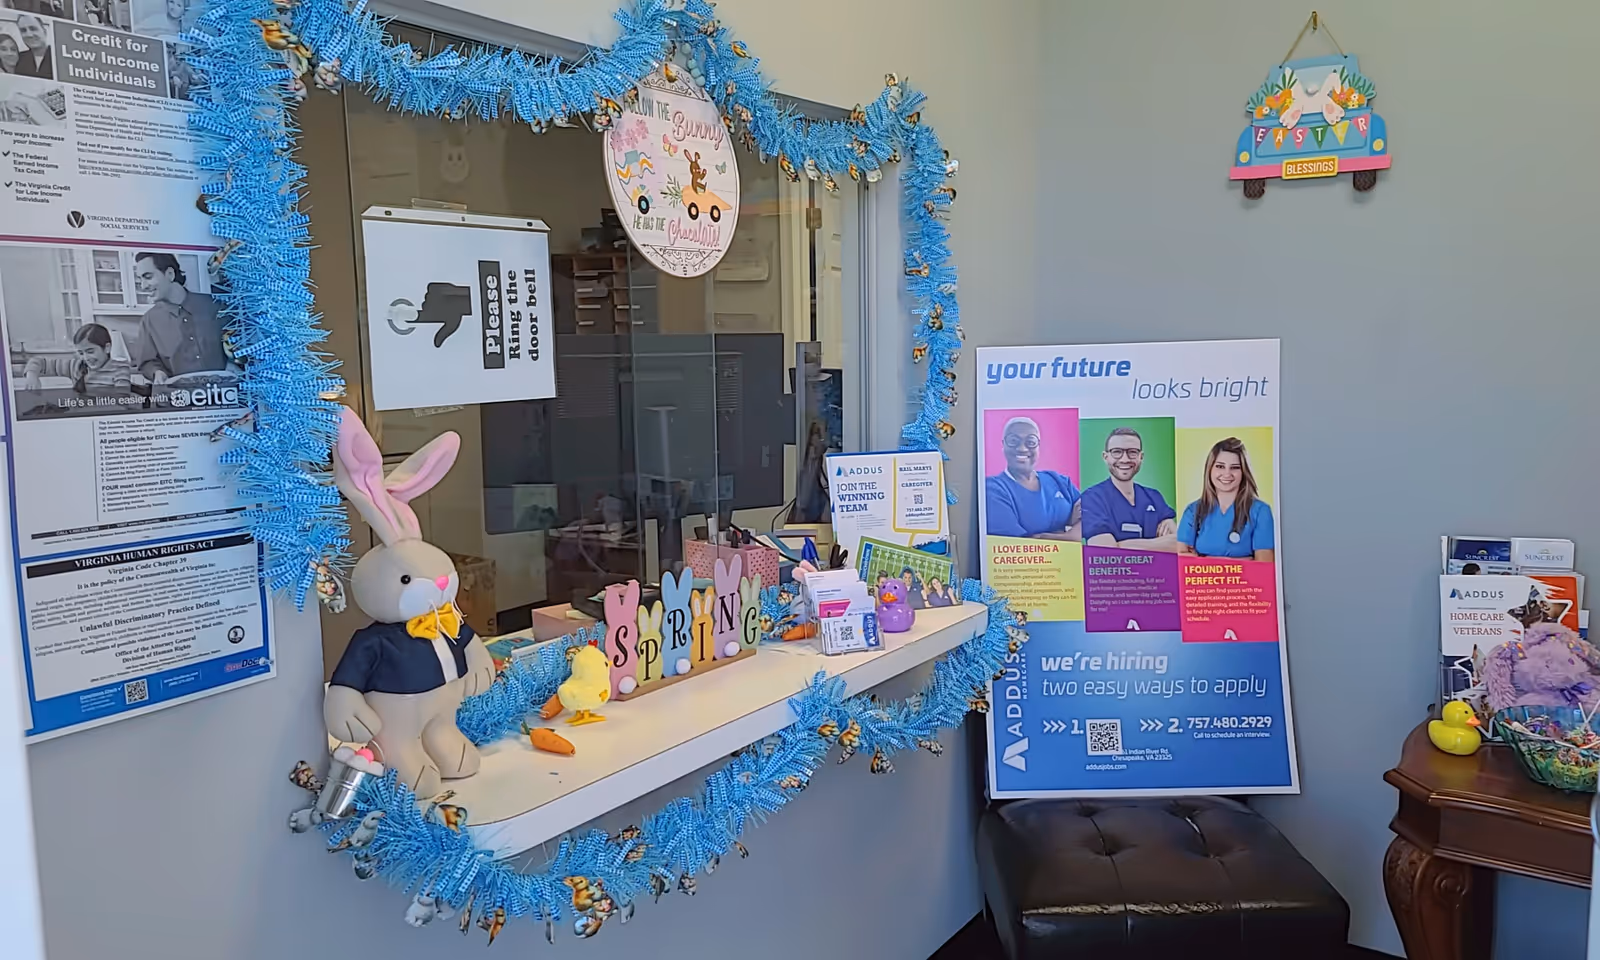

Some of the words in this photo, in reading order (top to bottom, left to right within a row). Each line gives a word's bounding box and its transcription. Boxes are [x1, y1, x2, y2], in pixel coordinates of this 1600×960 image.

[72, 28, 122, 49] Credit
[126, 39, 148, 53] for
[62, 45, 96, 62] Low
[101, 52, 159, 72] Income
[68, 64, 156, 88] Individuals
[656, 101, 670, 121] THE
[673, 111, 723, 150] Bunny
[506, 270, 518, 305] the
[524, 269, 537, 308] bell
[485, 275, 500, 355] Please
[509, 310, 522, 360] Ring
[527, 313, 539, 361] door
[987, 360, 1047, 384] your
[1052, 357, 1131, 378] future
[58, 398, 84, 407] Life's
[96, 396, 116, 405] little
[118, 395, 146, 404] easier
[149, 394, 168, 403] with
[192, 383, 238, 405] eitc
[1132, 379, 1191, 400] looks
[1200, 376, 1269, 402] bright
[850, 466, 882, 474] ADDUS
[837, 483, 858, 493] JOIN
[838, 492, 884, 502] WINNING
[839, 504, 868, 512] TEAM
[75, 554, 121, 568] VIRGINIA
[123, 547, 159, 560] HUMAN
[160, 543, 196, 555] RIGHTS
[197, 540, 214, 548] ACT
[101, 578, 117, 586] policy
[136, 568, 178, 580] Commonwealth
[108, 565, 134, 575] Virginia
[153, 560, 178, 568] Chapter
[1185, 577, 1225, 585] PERFECT
[80, 621, 112, 632] Unlawful
[114, 611, 165, 626] Discriminatory
[168, 606, 194, 615] Practice
[196, 600, 220, 610] Defined
[613, 593, 758, 681] SPRING
[1453, 627, 1502, 635] VETERANS
[115, 649, 132, 657] Office
[150, 641, 174, 649] Attorney
[175, 635, 196, 644] General
[122, 653, 145, 663] Division
[174, 645, 191, 653] Rights
[1041, 652, 1102, 672] we're
[1107, 651, 1168, 673] hiring
[1004, 653, 1023, 737] ADDUS
[1042, 679, 1077, 696] two
[1084, 680, 1128, 699] easy
[1135, 679, 1184, 698] ways
[1191, 677, 1208, 694] to
[1214, 675, 1267, 698] apply
[1071, 719, 1084, 734] 1.
[1168, 718, 1183, 733] 2.
[1187, 717, 1272, 728] 757.480.2929
